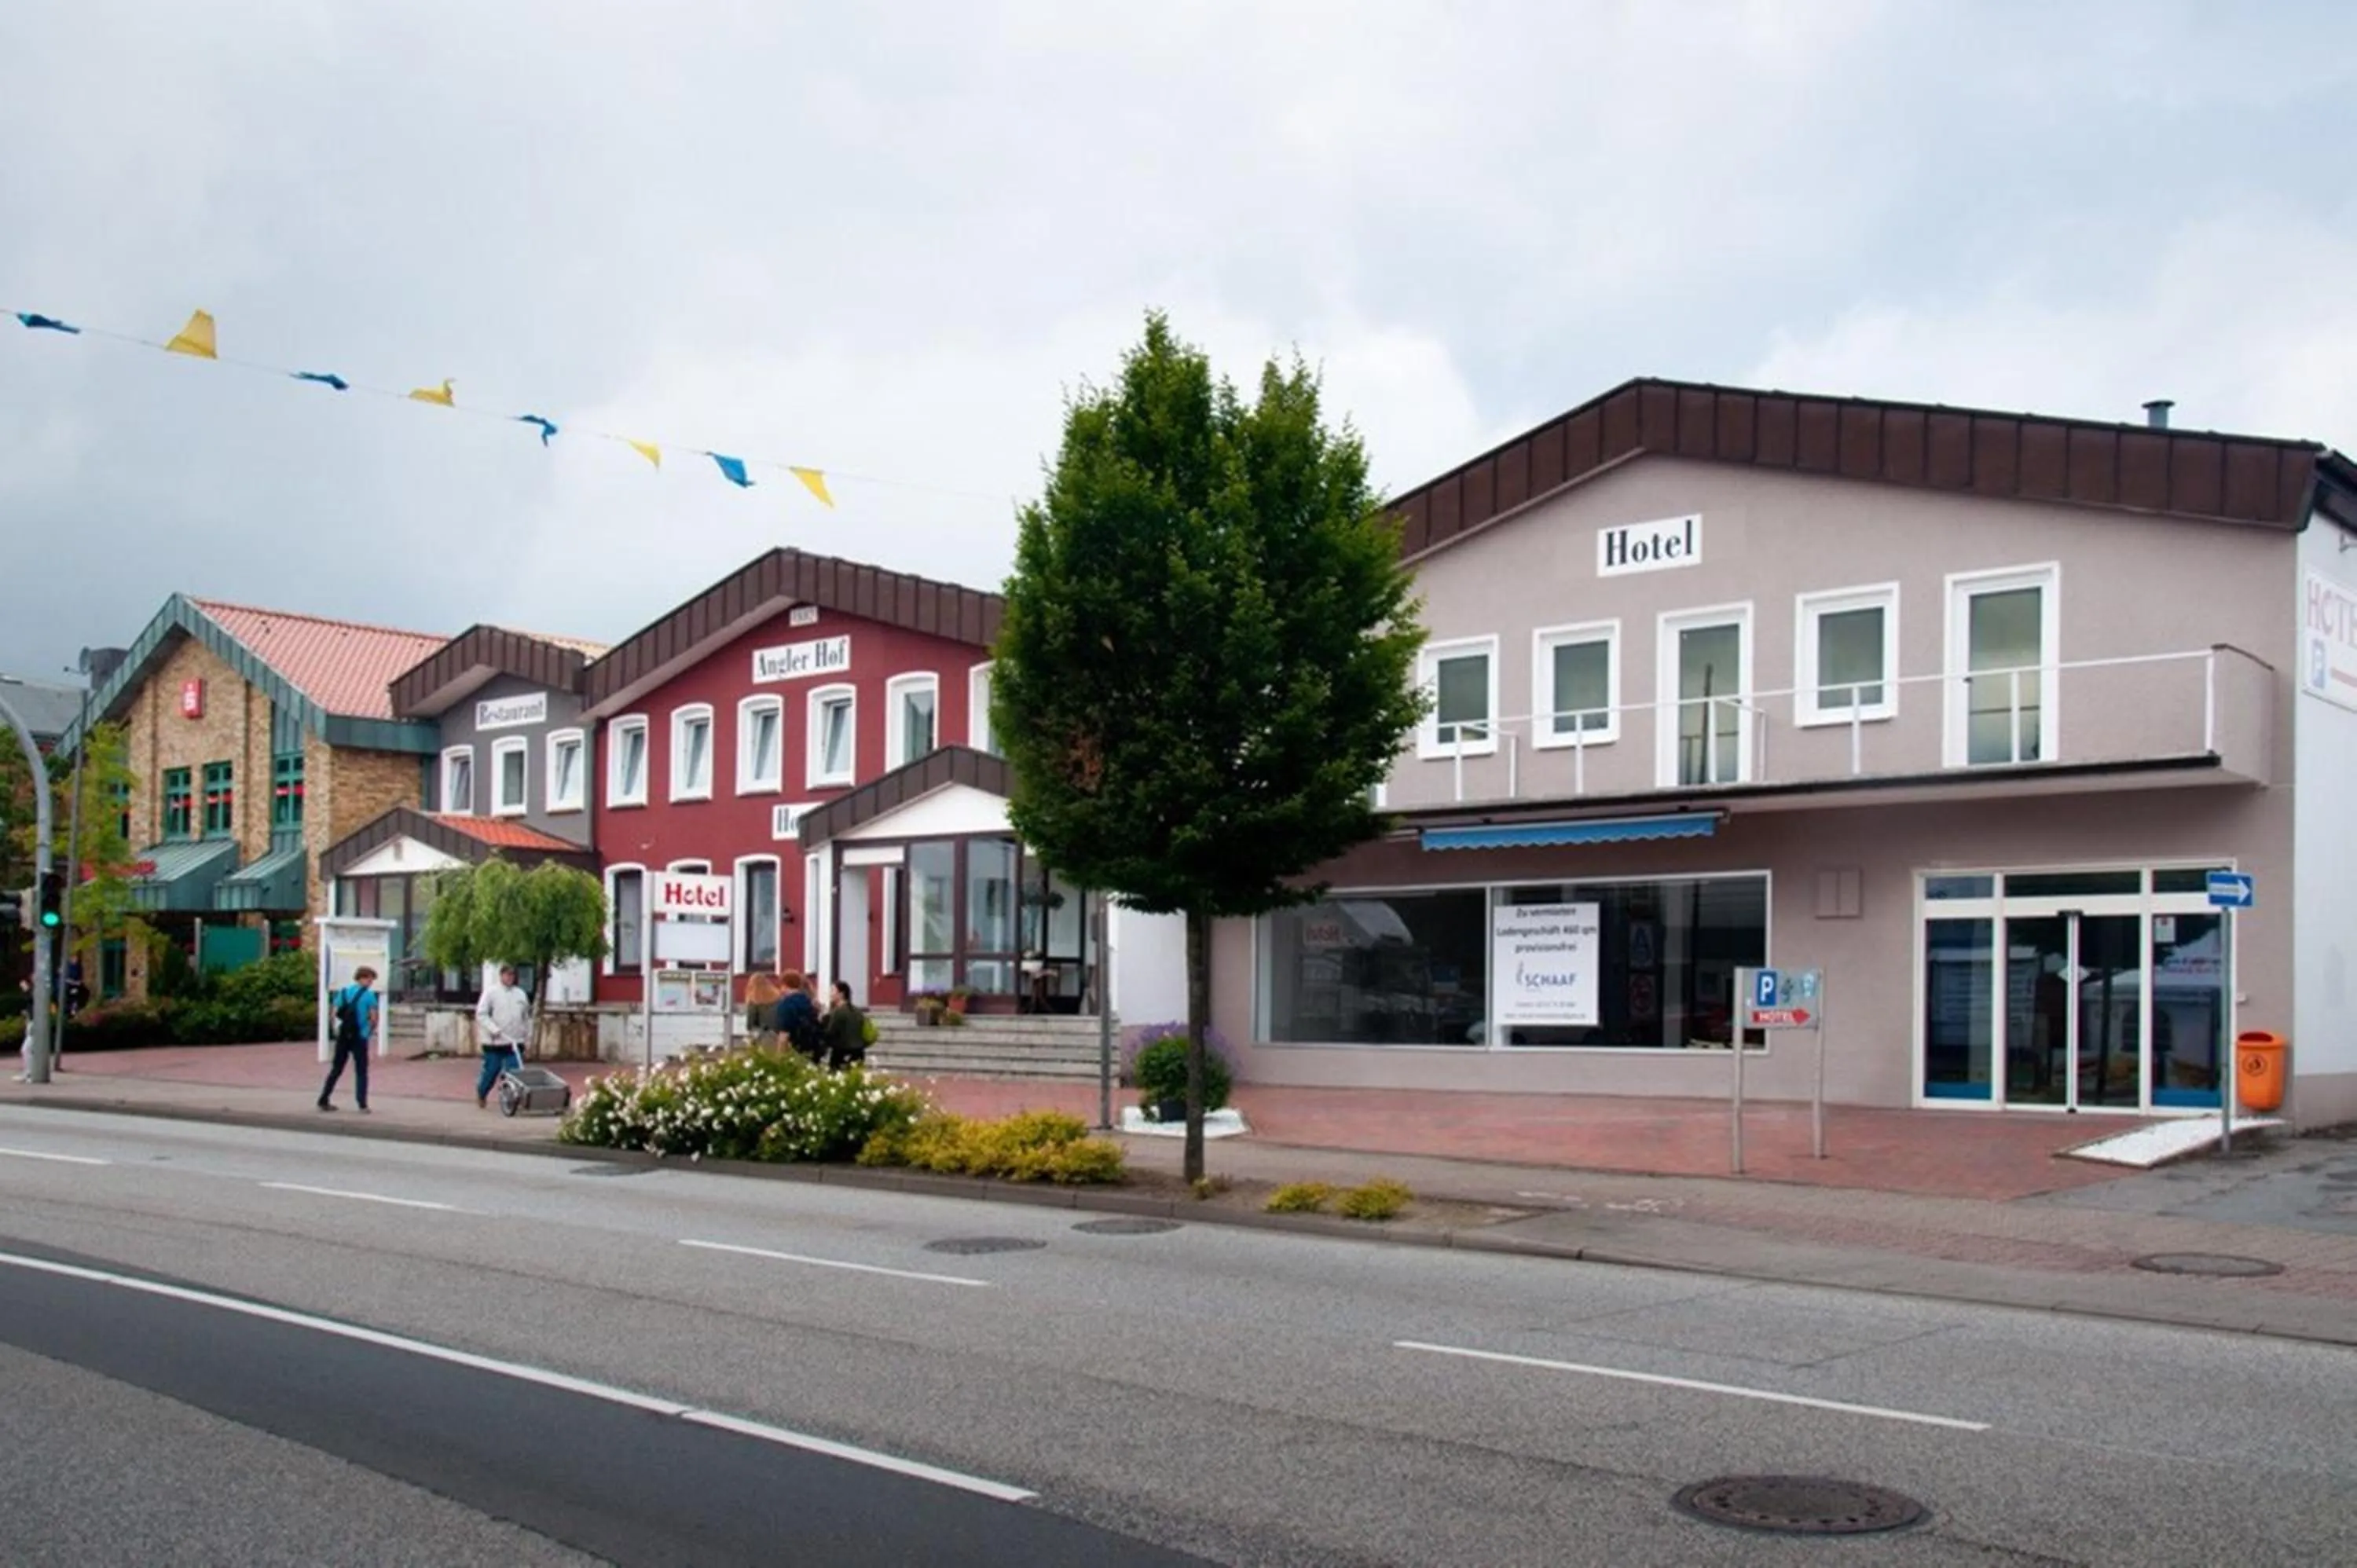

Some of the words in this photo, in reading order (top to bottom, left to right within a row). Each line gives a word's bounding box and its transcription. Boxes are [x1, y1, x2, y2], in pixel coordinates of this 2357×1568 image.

[1606, 519, 1692, 566] Hotel
[758, 648, 809, 679] Angler
[816, 639, 846, 668] Hof
[665, 881, 725, 907] Hotel
[1524, 973, 1576, 987] SCHAAF
[1760, 975, 1774, 1002] P
